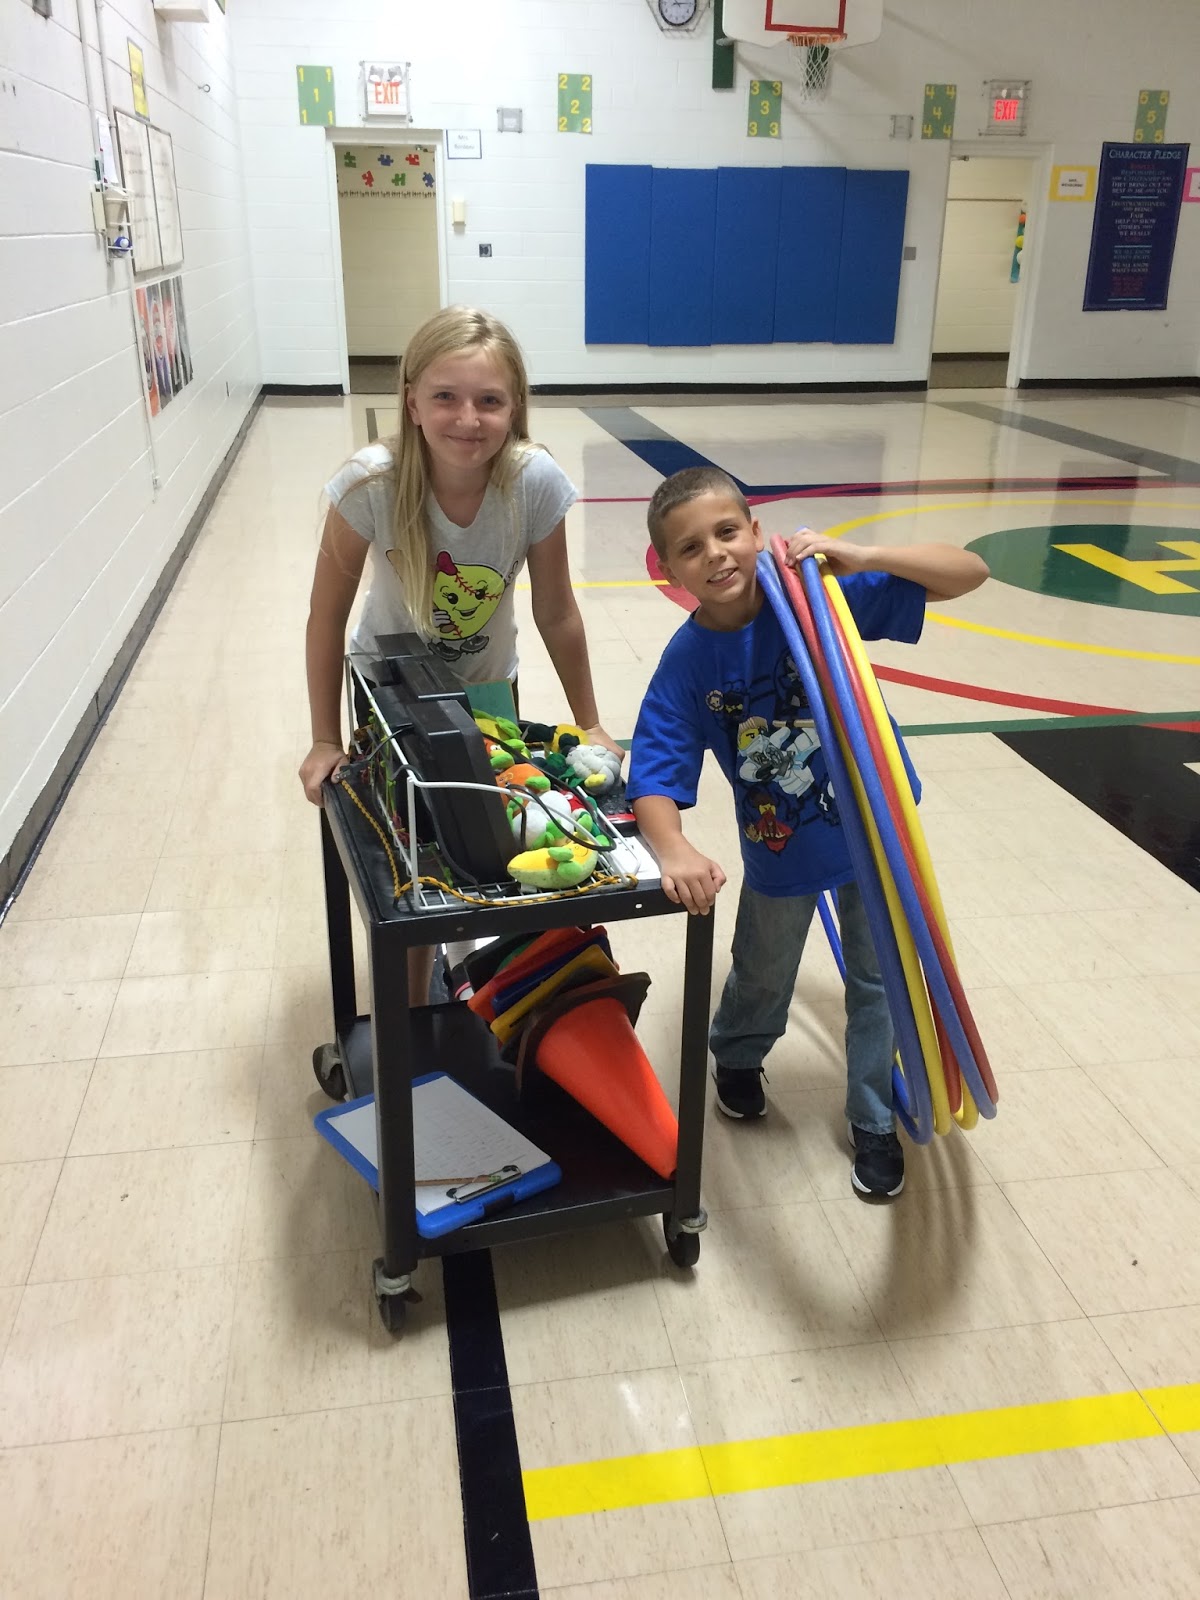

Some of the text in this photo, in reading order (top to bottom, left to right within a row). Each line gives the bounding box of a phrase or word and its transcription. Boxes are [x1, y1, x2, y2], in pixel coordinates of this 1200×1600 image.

[298, 67, 304, 82] 1
[325, 67, 332, 82] 1
[559, 74, 568, 89] 2
[581, 76, 591, 91] 2
[751, 81, 760, 95] 3
[772, 82, 781, 96] 3
[312, 88, 319, 103] 1
[374, 81, 400, 105] EXIT
[926, 86, 935, 100] 4
[946, 86, 955, 100] 4
[1140, 91, 1149, 105] 5
[1160, 91, 1169, 106] 5
[570, 99, 580, 114] 2
[760, 100, 769, 115] 3
[932, 106, 942, 120] 4
[994, 99, 1019, 121] EXIT
[301, 109, 307, 124] 1
[327, 110, 333, 125] 1
[559, 116, 568, 131] 2
[1147, 110, 1156, 124] 5
[582, 118, 592, 132] 2
[749, 121, 758, 136] 3
[769, 122, 779, 136] 3
[923, 124, 932, 138] 4
[943, 124, 952, 138] 4
[1135, 128, 1144, 142] 5
[1154, 129, 1163, 143] 5
[1109, 149, 1182, 160] CHARACTER PLEDGE
